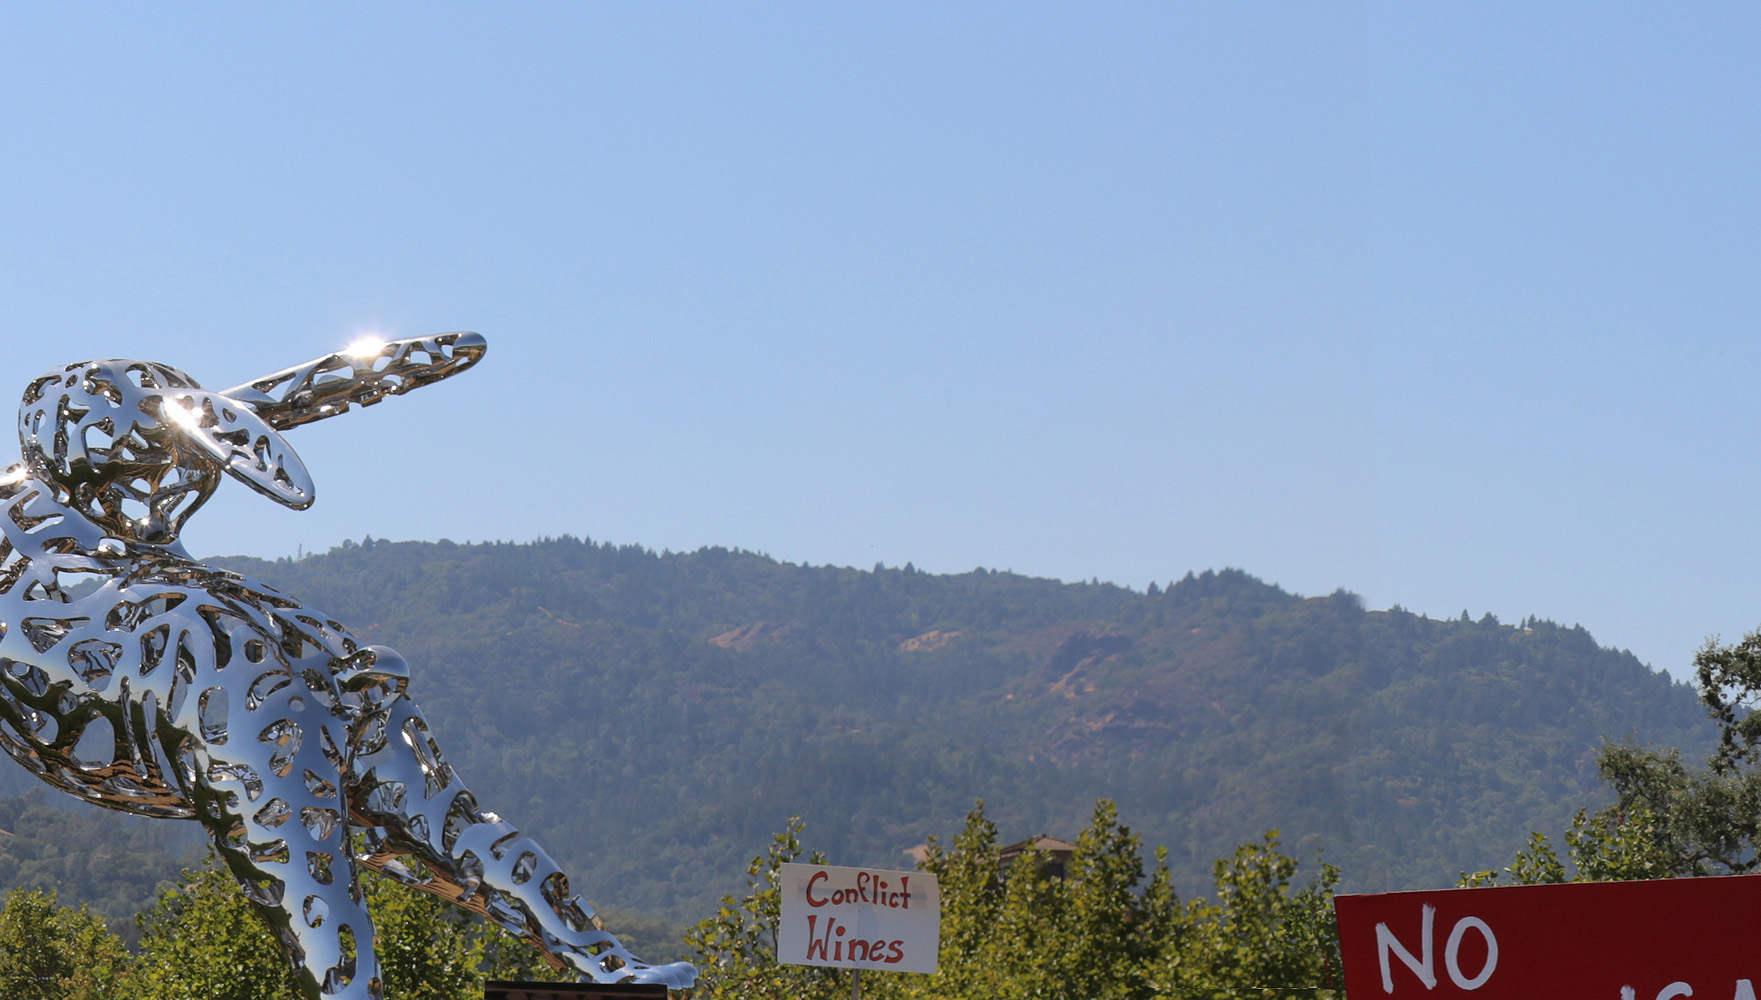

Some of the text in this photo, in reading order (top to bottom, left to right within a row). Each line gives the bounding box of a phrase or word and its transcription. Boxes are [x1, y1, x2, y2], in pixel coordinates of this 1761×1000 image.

[806, 871, 911, 909] Conflict
[807, 915, 904, 963] Wines
[1375, 903, 1499, 994] NO
